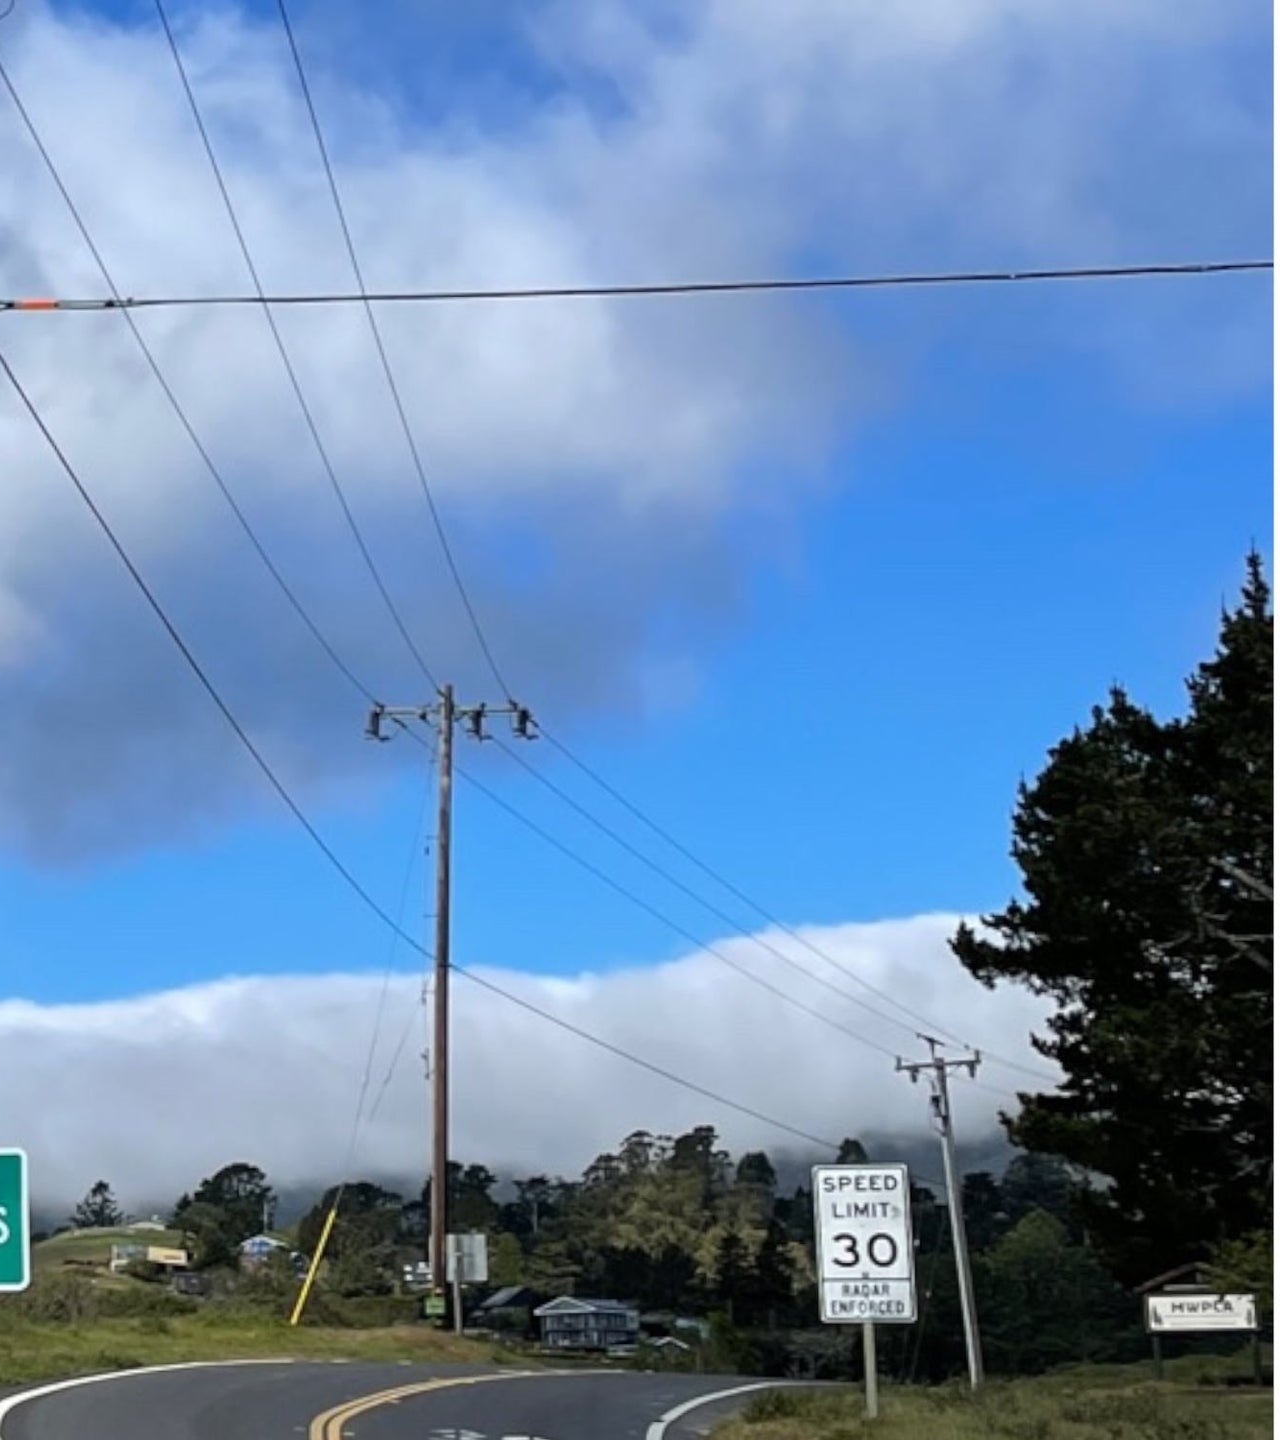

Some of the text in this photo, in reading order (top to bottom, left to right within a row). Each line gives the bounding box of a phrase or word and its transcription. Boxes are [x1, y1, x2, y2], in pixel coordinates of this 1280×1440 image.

[823, 1175, 898, 1193] SPEED
[832, 1202, 889, 1218] LIMIT
[831, 1232, 898, 1268] 30
[841, 1284, 890, 1297] RADAR
[831, 1300, 905, 1317] ENFORCED
